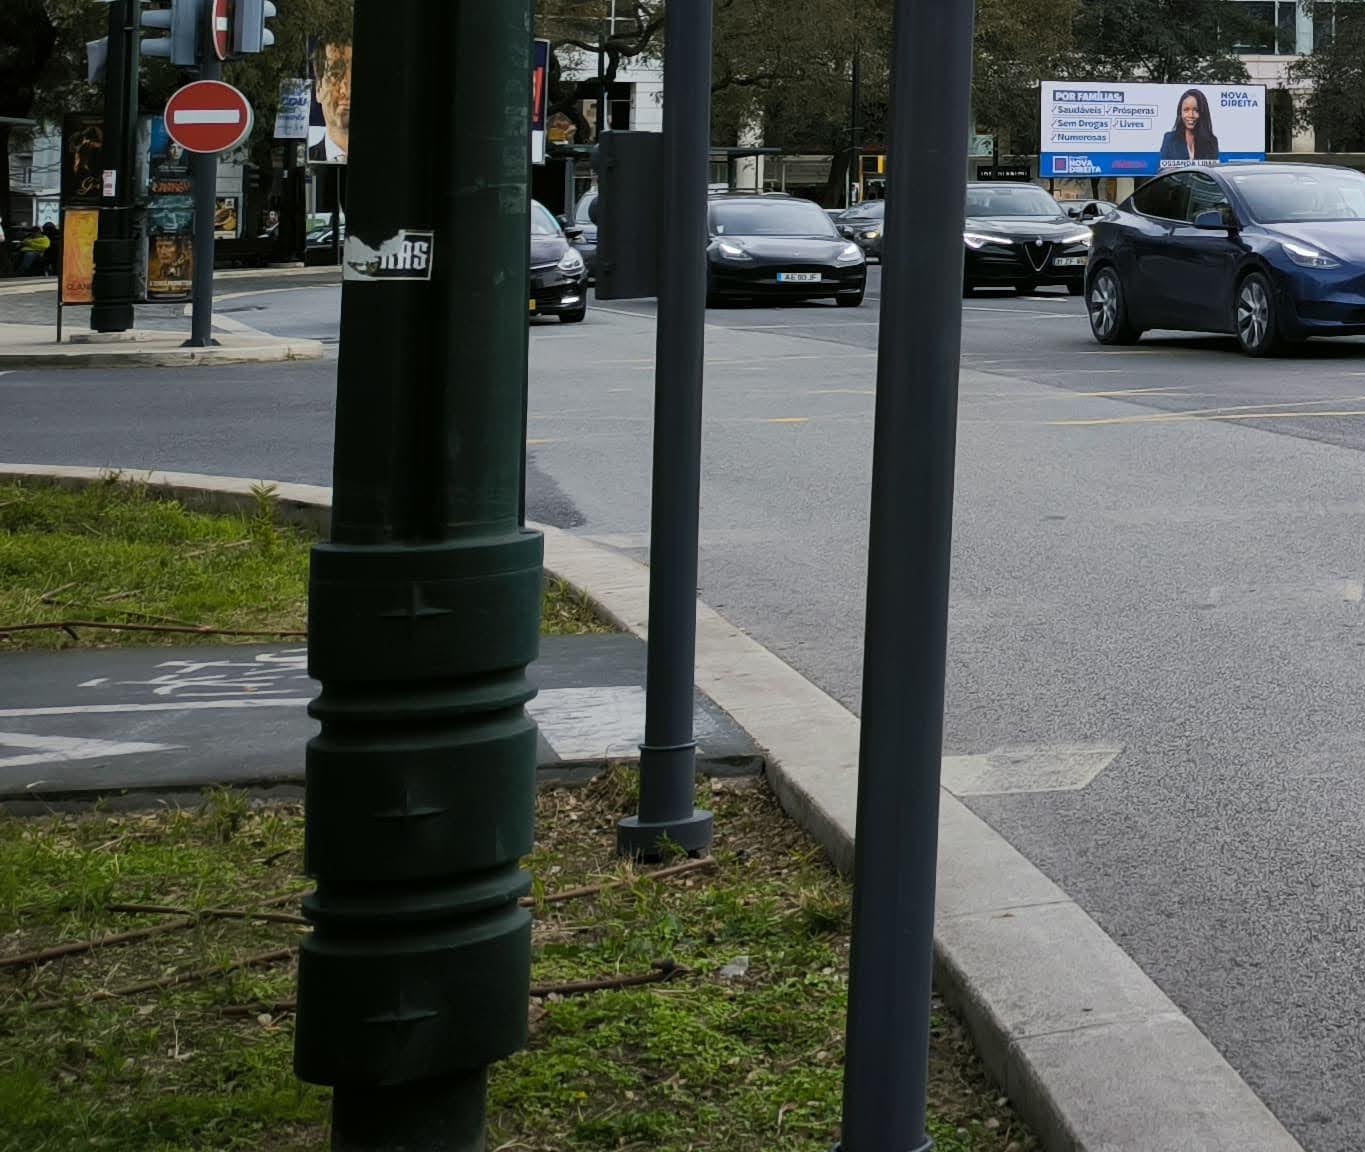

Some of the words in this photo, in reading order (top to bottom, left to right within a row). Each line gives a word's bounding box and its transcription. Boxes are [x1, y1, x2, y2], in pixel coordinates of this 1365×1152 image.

[1055, 91, 1075, 102] POR
[1220, 91, 1248, 99] NOVA
[1220, 99, 1259, 107] DIREITA
[1057, 104, 1102, 114] Saudáveis
[1112, 105, 1155, 116] Prósperas
[1057, 119, 1077, 127] Sem
[1078, 119, 1109, 129] Drogas
[1119, 119, 1145, 128] Livres
[1057, 133, 1107, 141] Numerosas
[1068, 159, 1094, 167] NOVA
